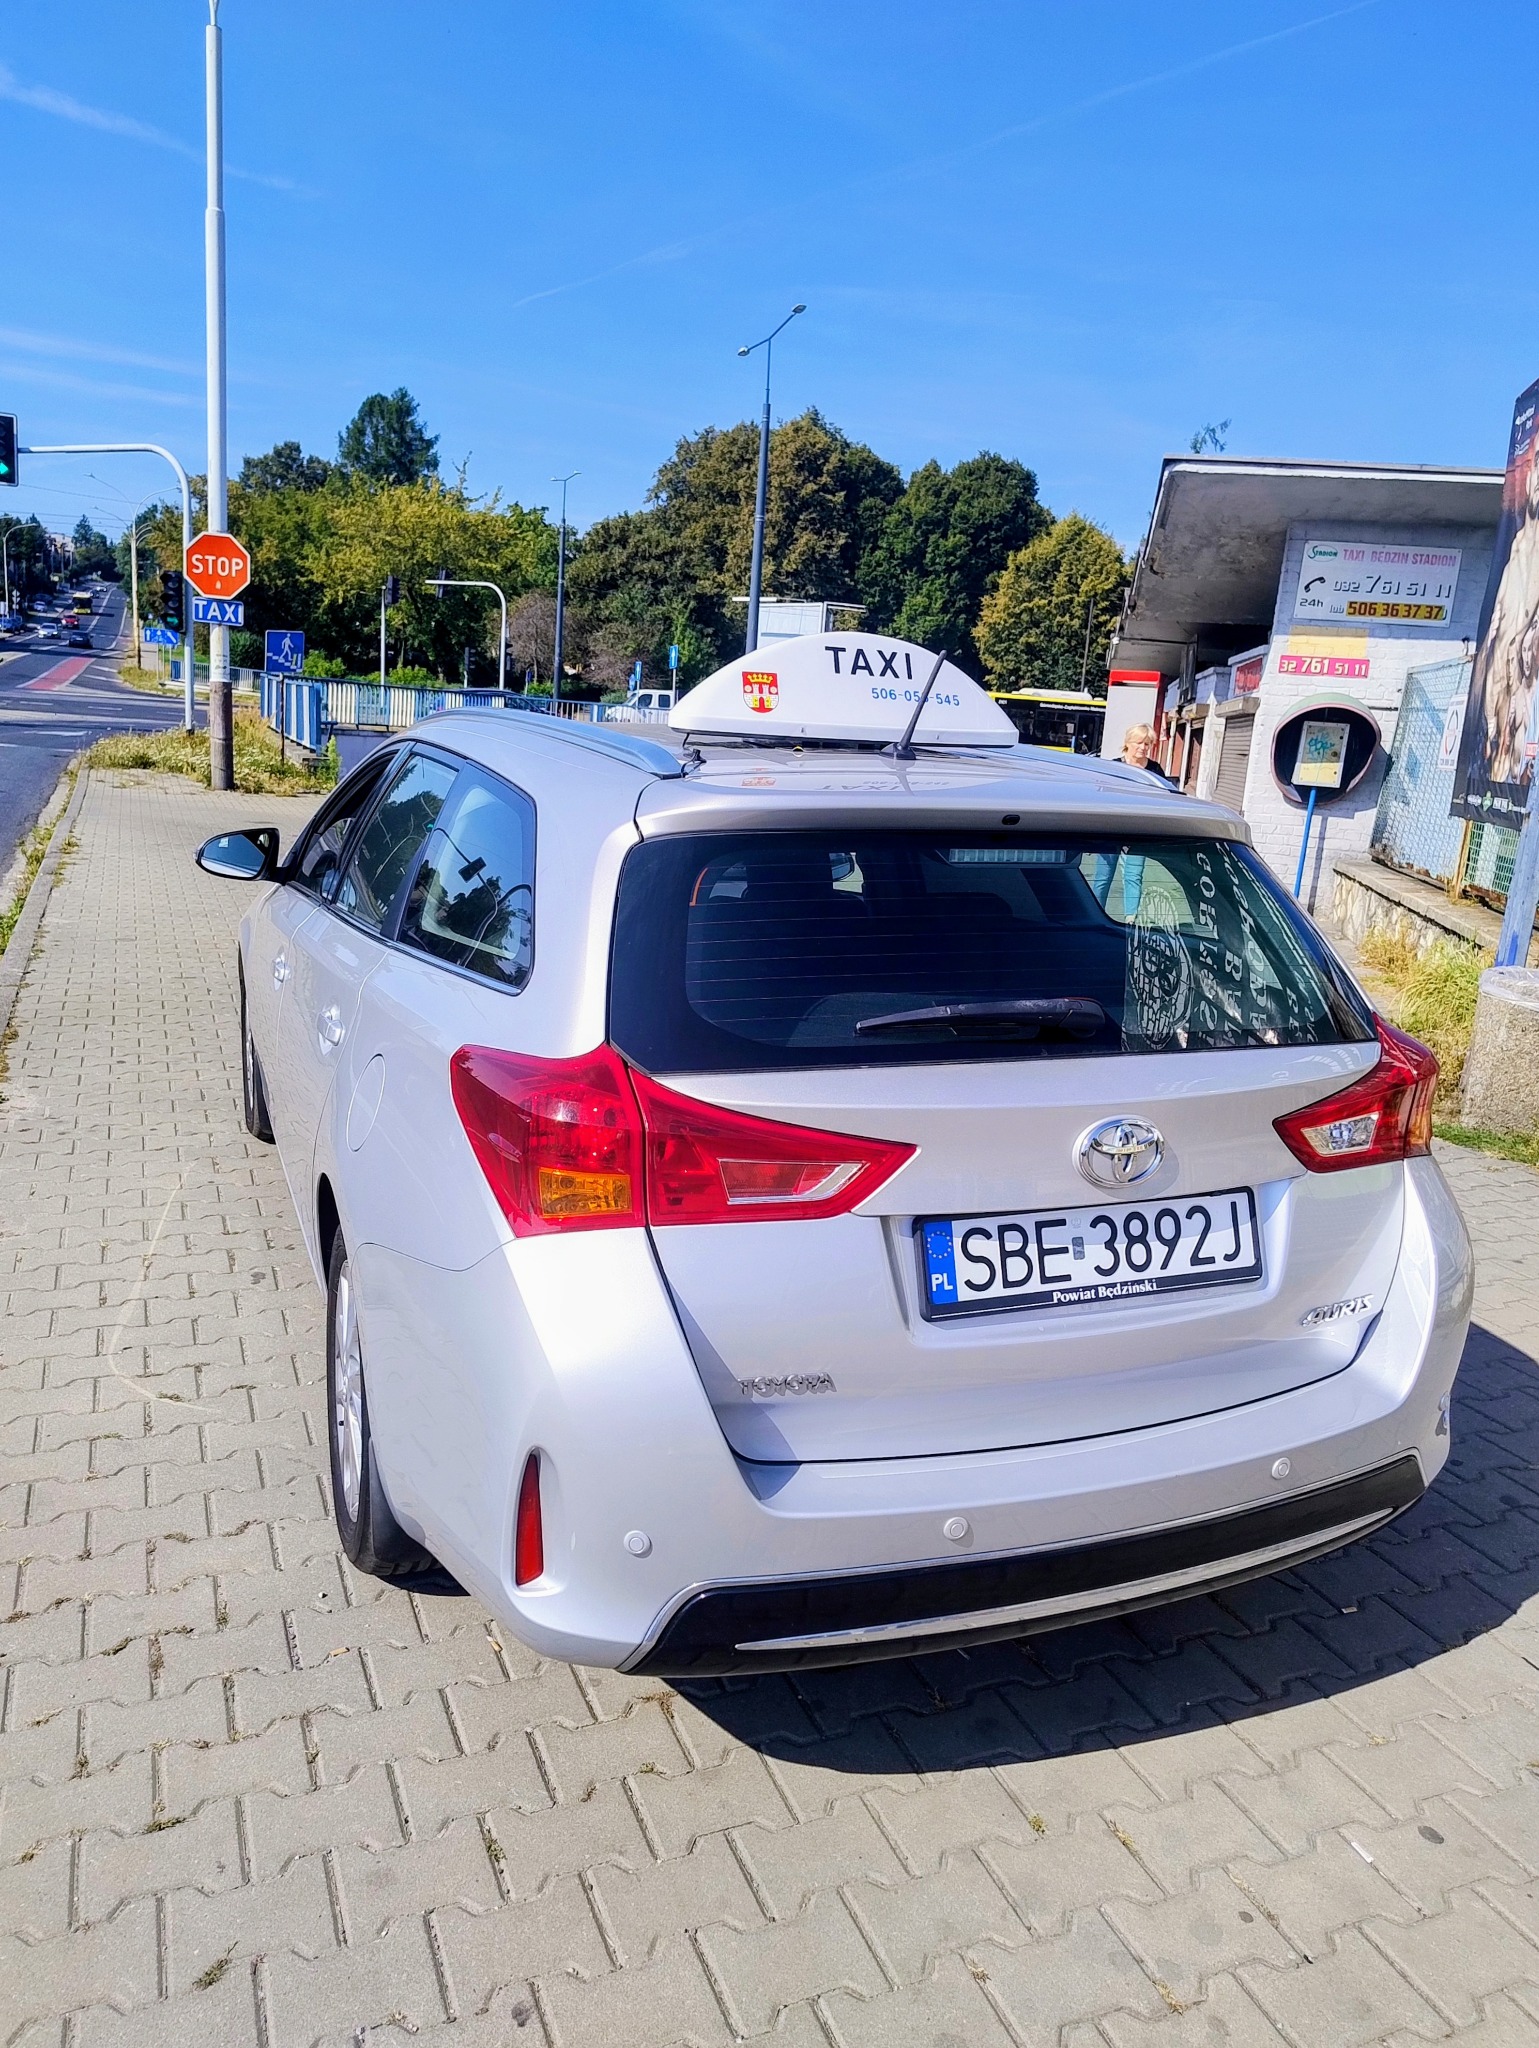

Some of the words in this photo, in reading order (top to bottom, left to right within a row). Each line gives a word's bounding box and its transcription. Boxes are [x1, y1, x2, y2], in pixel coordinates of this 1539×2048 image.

[191, 554, 244, 577] STOP
[1343, 549, 1365, 561] TAXI
[1411, 553, 1457, 567] STADION
[1365, 575, 1401, 595] 761
[1406, 582, 1427, 597] 51
[1436, 584, 1452, 598] 11
[193, 600, 243, 623] TAXI
[1299, 598, 1324, 608] 24h
[1347, 601, 1377, 617] 506
[1380, 603, 1400, 617] 36
[1402, 604, 1421, 619] 37
[1424, 605, 1443, 619] 37
[825, 646, 913, 680] TAXI
[1280, 660, 1297, 672] 32
[1301, 657, 1330, 674] 761
[1334, 662, 1349, 675] 51
[1354, 663, 1366, 676] 11
[961, 1218, 1072, 1292] SBE
[1089, 1201, 1241, 1277] 3892J
[931, 1272, 954, 1292] PL
[1052, 1288, 1096, 1303] Powiat
[1098, 1279, 1158, 1299] Będziński
[1301, 1293, 1374, 1327] AURIS
[737, 1372, 837, 1397] TOYOTA
